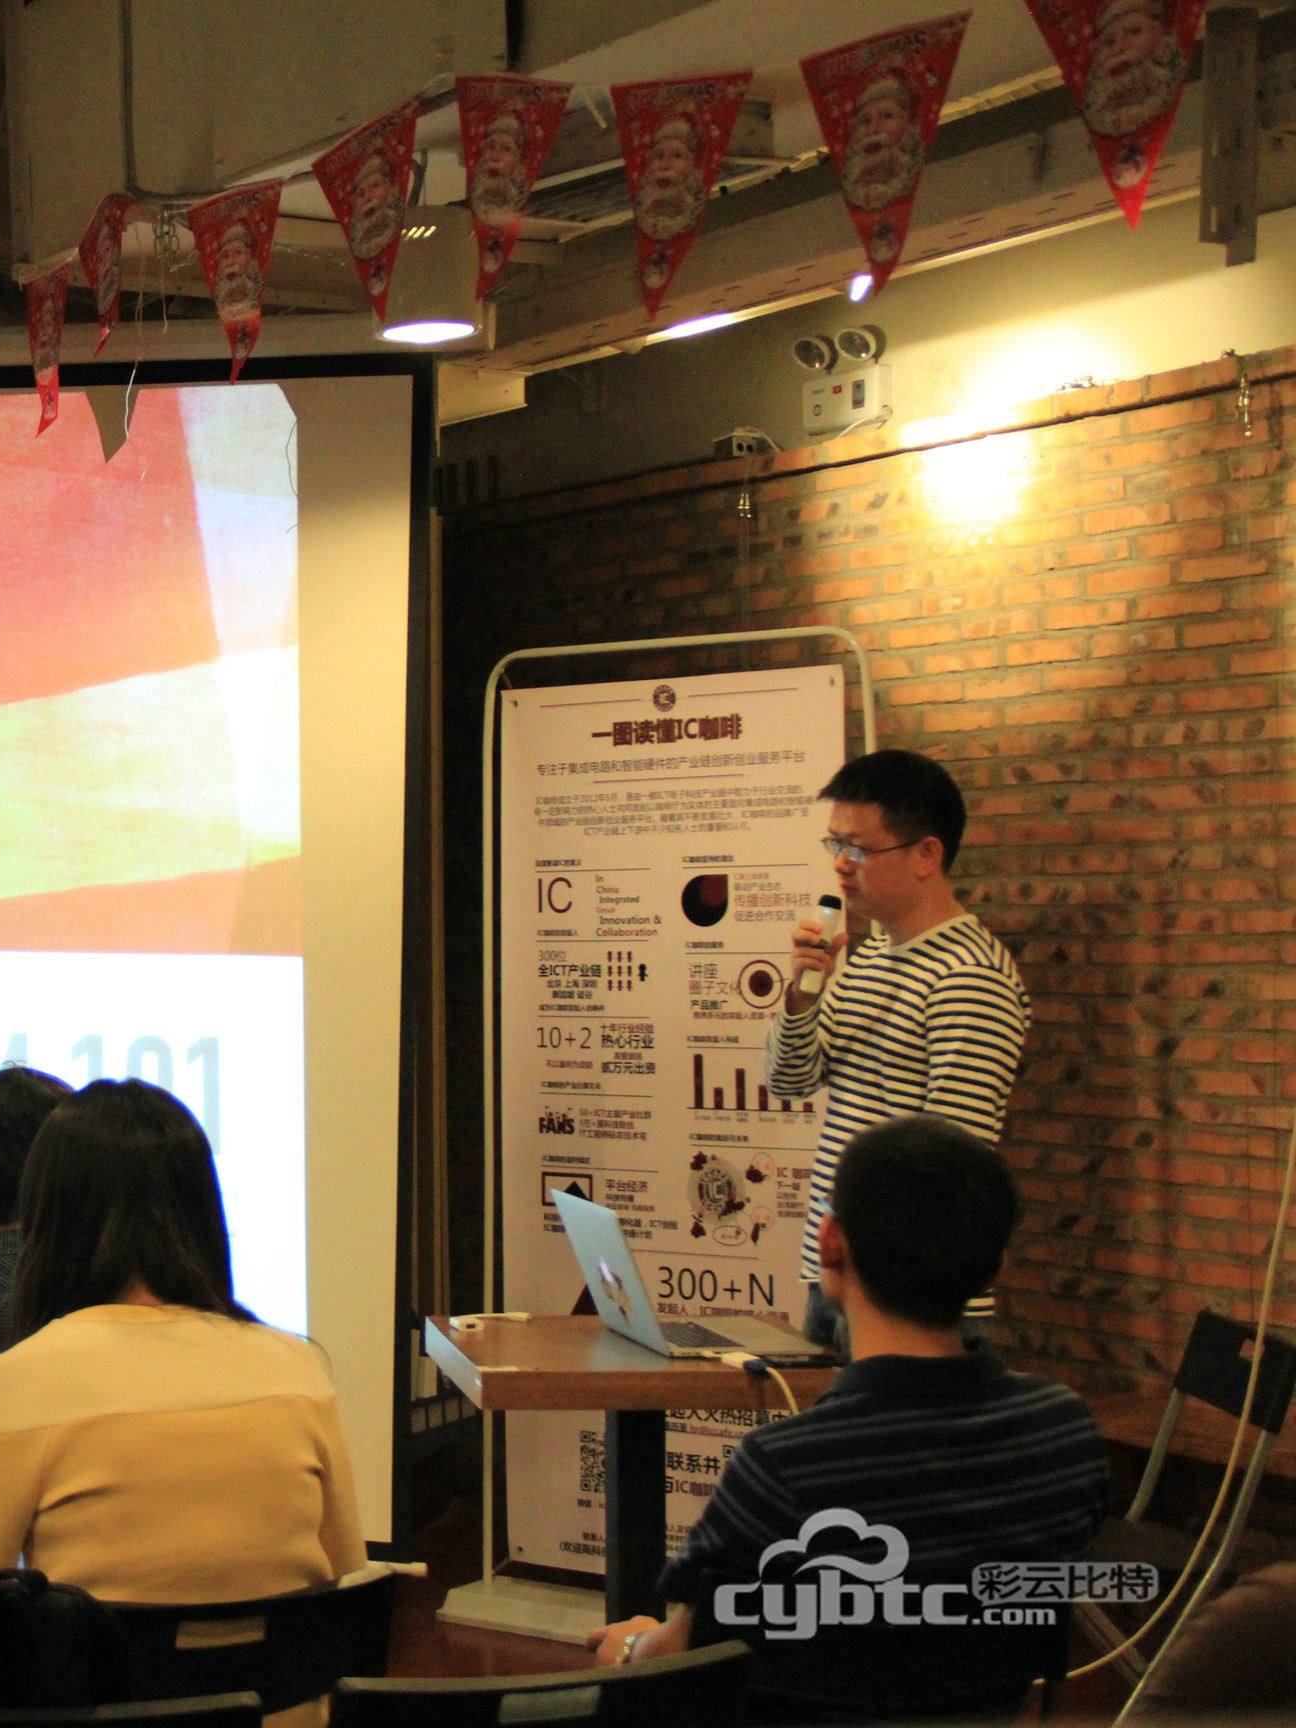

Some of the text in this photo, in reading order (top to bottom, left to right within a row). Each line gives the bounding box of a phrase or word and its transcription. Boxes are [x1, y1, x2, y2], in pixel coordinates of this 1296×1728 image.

[592, 713, 742, 746] 一图读懂IC咖啡
[537, 876, 573, 913] IC
[596, 885, 620, 894] China
[599, 895, 640, 906] Integrated
[599, 914, 662, 925] Innovation &
[595, 927, 658, 937] Collaboration
[536, 1026, 592, 1049] 10+2
[657, 1266, 774, 1306] 300+N
